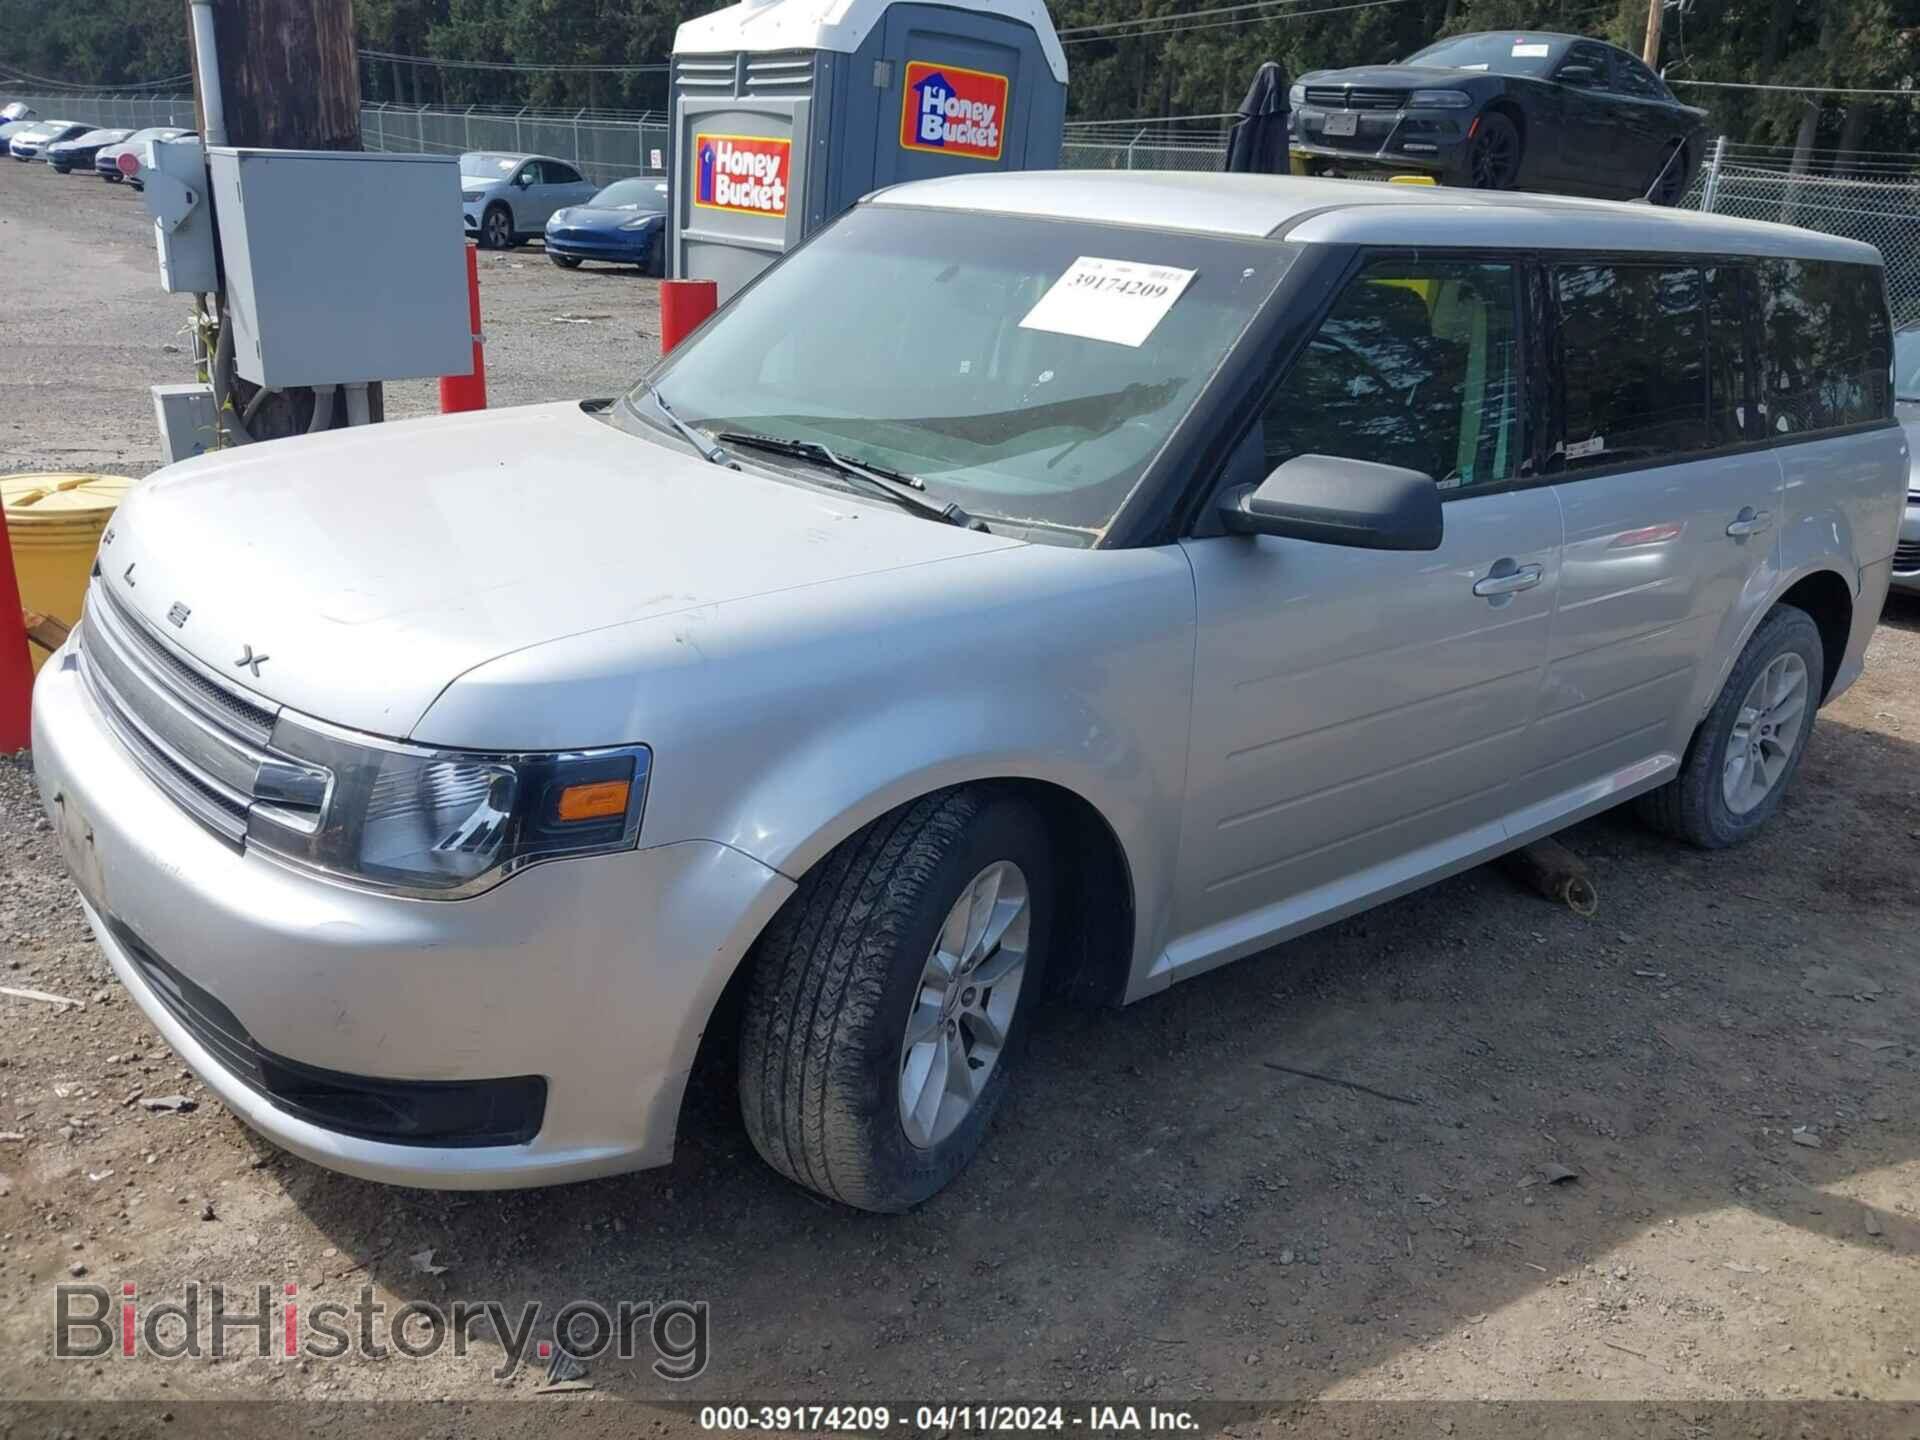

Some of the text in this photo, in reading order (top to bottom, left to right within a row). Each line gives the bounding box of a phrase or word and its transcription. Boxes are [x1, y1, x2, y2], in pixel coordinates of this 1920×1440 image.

[922, 86, 996, 126] Honey
[920, 119, 998, 148] Bucket
[716, 141, 780, 181] Honey
[715, 174, 785, 211] Bucket
[1075, 273, 1168, 298] 39174209
